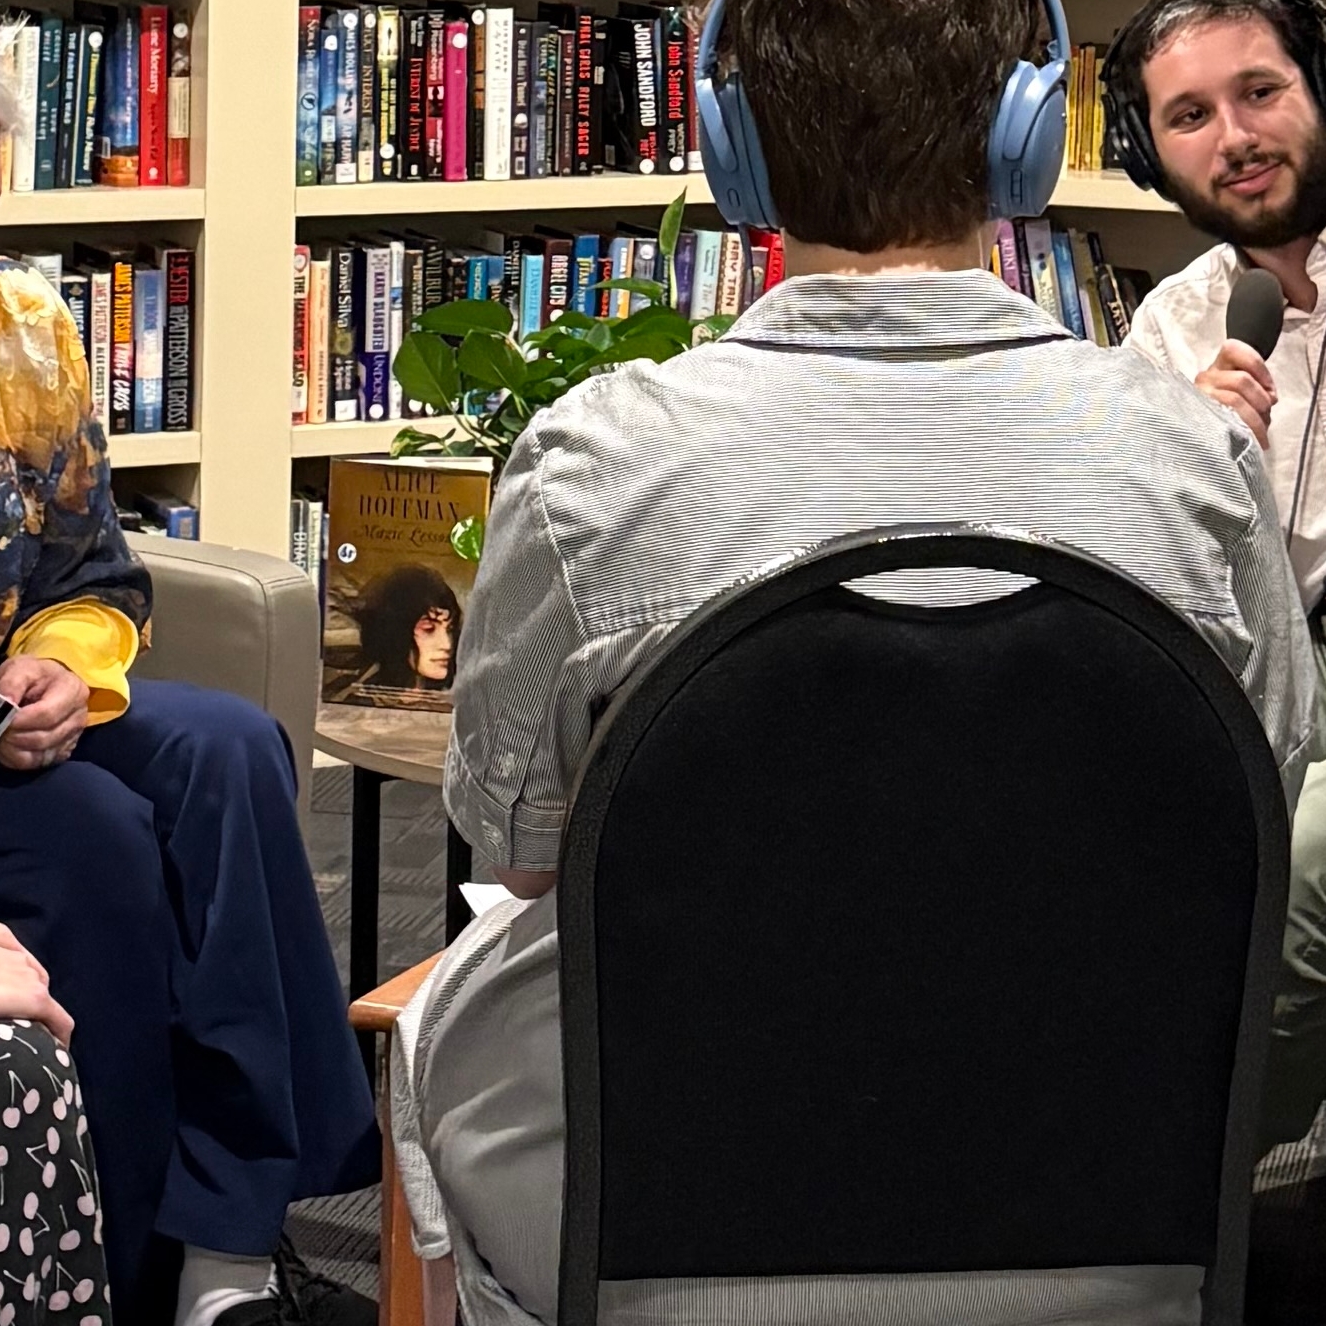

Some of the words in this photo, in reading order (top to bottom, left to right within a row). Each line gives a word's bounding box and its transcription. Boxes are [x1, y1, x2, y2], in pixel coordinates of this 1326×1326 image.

[633, 23, 653, 60] JOHN
[667, 40, 682, 66] John
[636, 61, 657, 127] SANDFORD
[668, 68, 684, 119] Sandford
[294, 275, 306, 295] THE
[339, 252, 351, 294] Daniel
[337, 295, 352, 329] Silva
[168, 314, 189, 377] PATTERSON
[380, 472, 442, 495] ALICE
[358, 494, 460, 522] HOFFMAN
